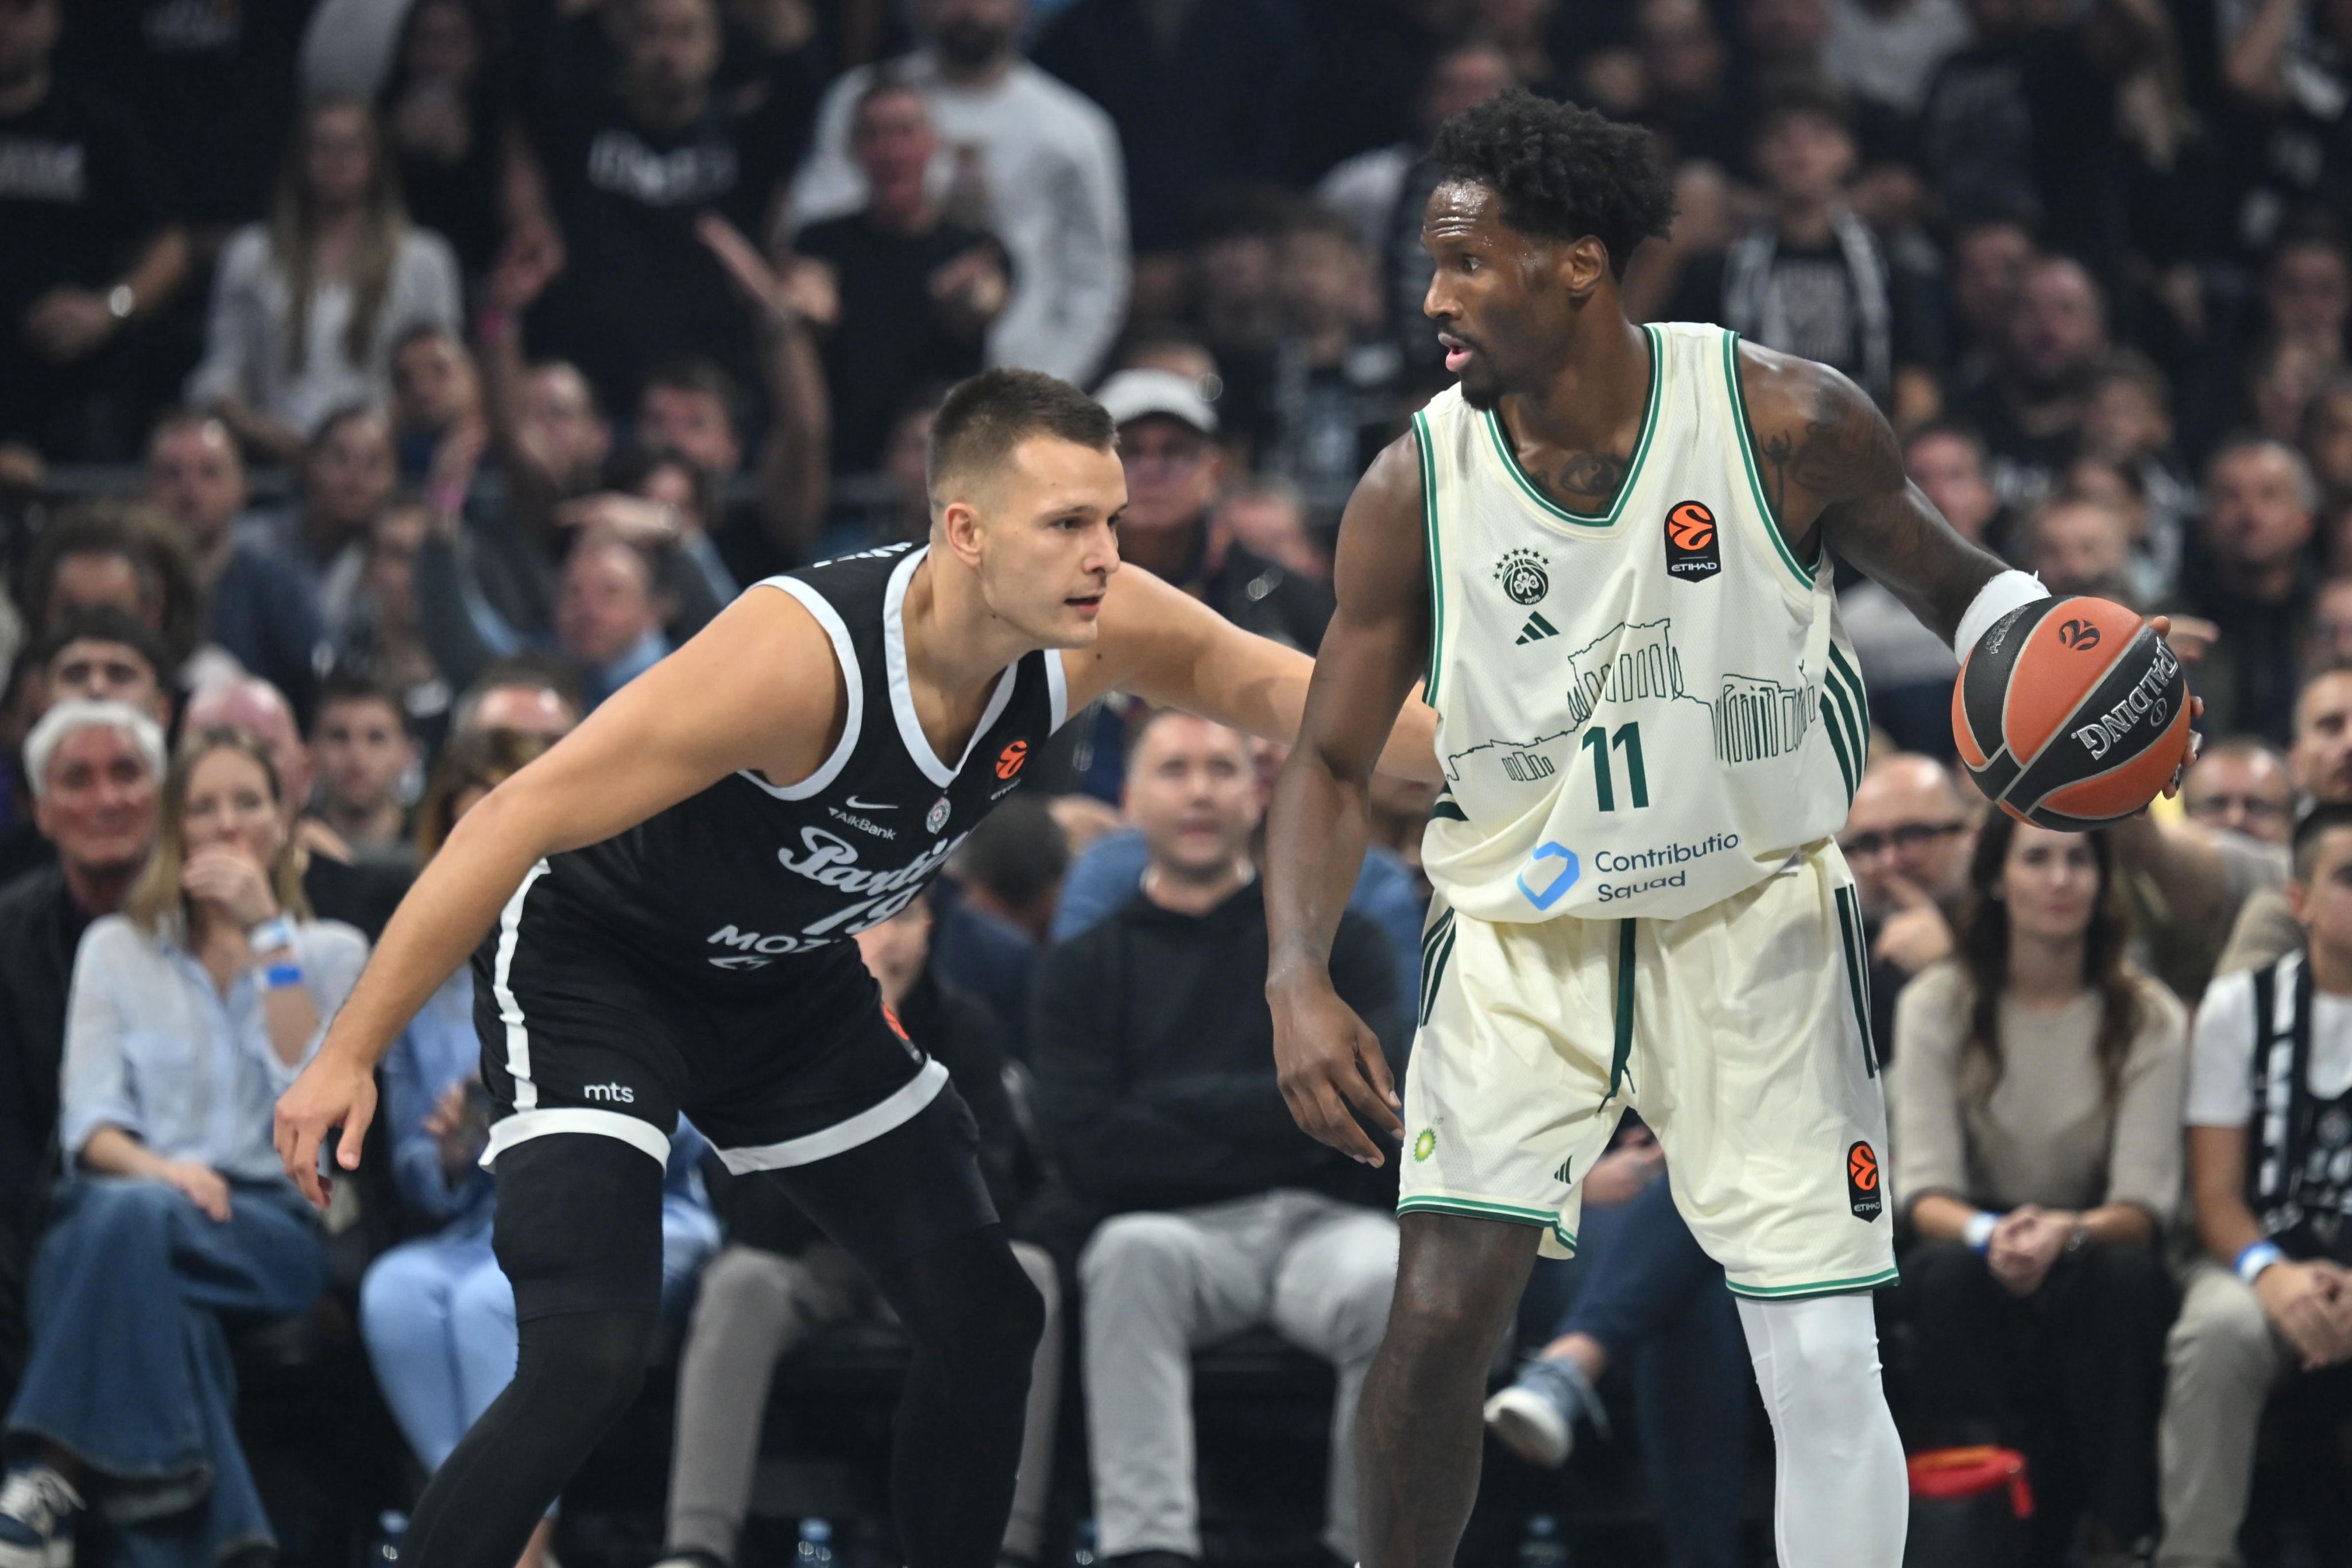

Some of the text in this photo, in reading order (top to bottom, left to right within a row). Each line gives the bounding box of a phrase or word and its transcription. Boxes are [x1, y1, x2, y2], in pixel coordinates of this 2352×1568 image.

[1671, 562, 1717, 572] ETIHAD
[1582, 721, 1649, 811] 11
[1597, 870, 1685, 902] Squad
[584, 1081, 635, 1104] mts
[1854, 1202, 1881, 1212] ETIHAD
